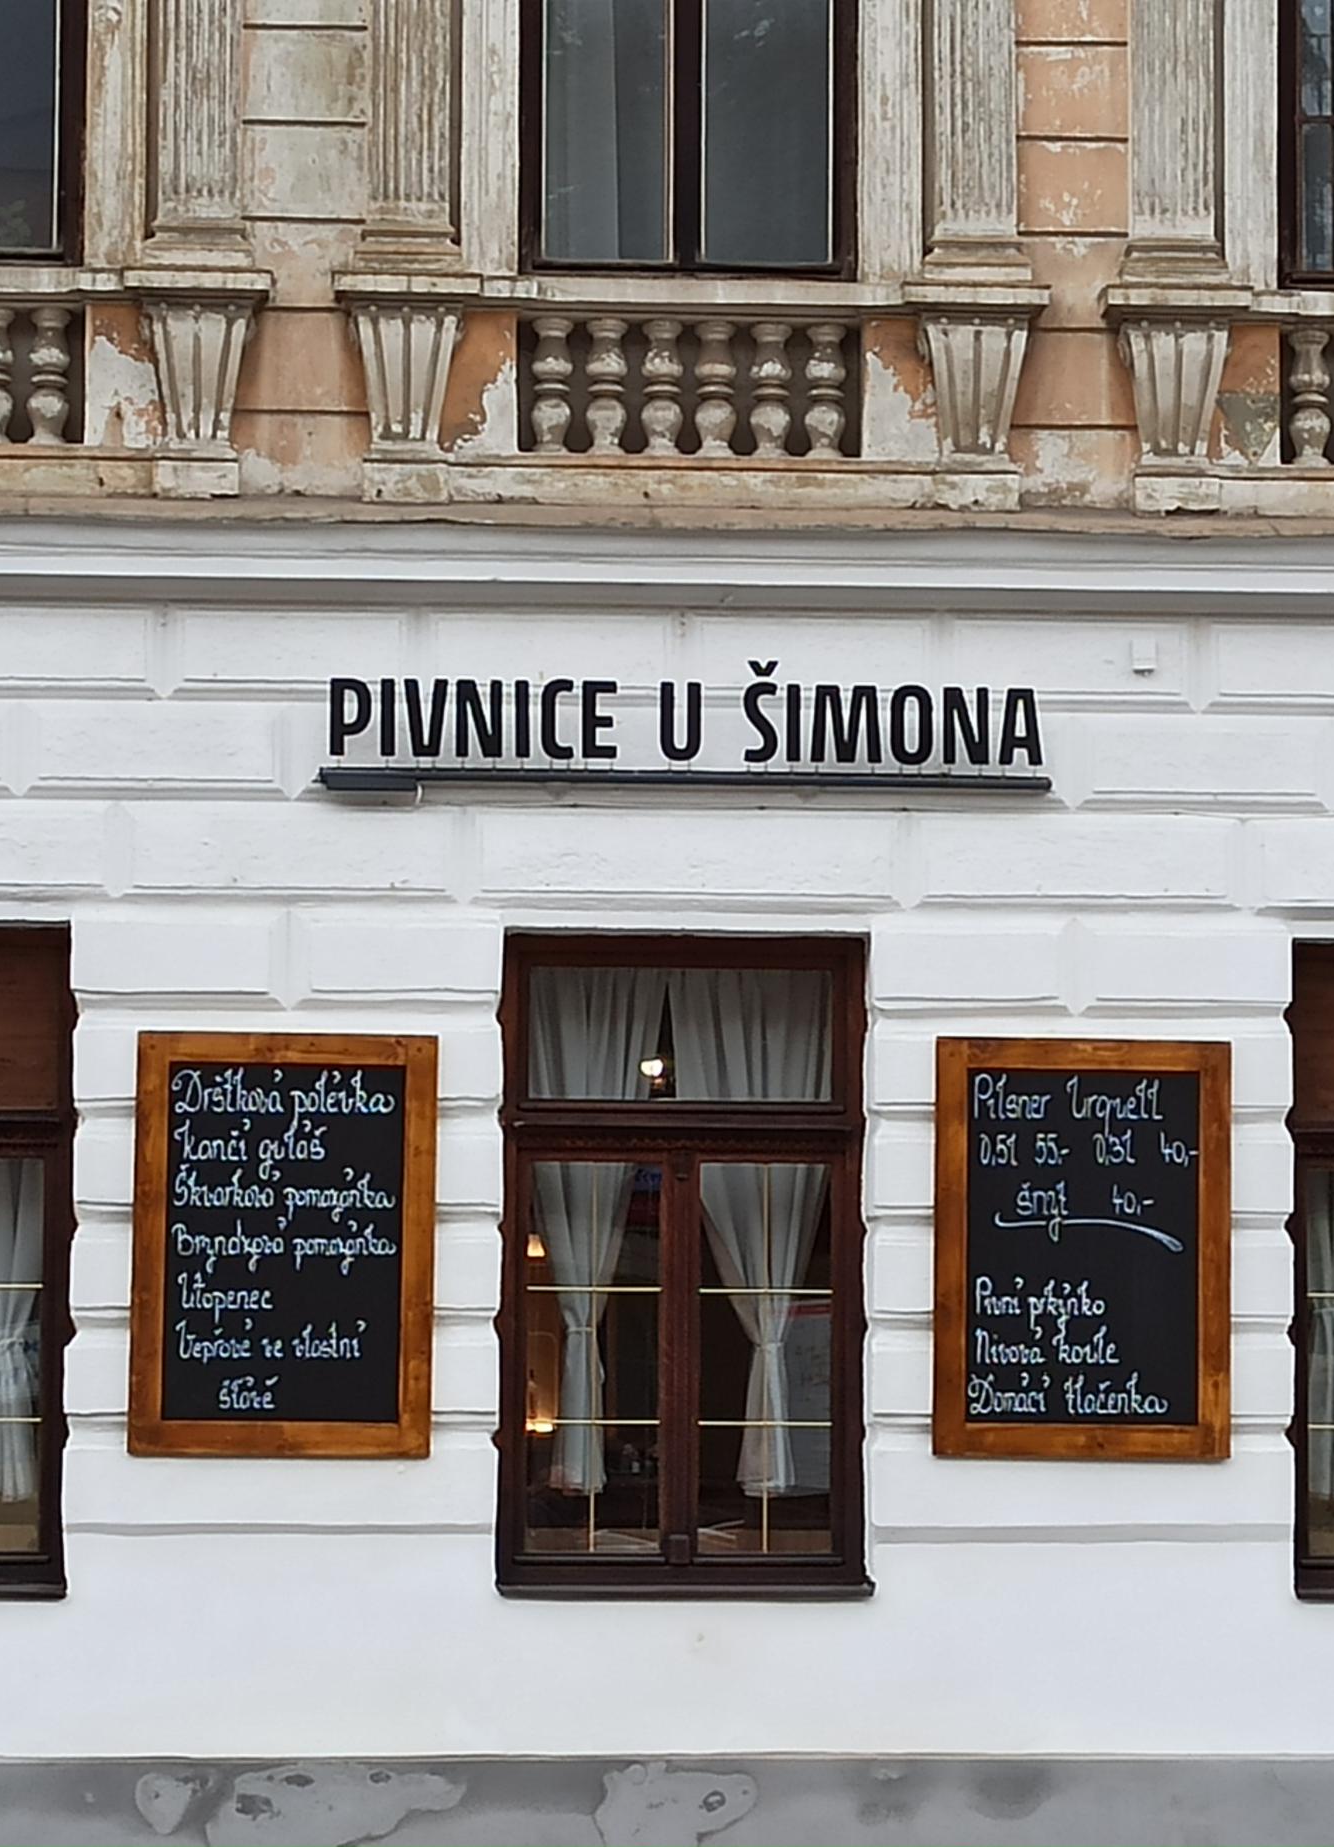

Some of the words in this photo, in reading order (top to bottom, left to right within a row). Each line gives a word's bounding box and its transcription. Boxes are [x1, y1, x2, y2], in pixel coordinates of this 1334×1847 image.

[329, 676, 618, 760] PIVNICE
[660, 680, 703, 762] U
[742, 659, 1046, 766] ŠIMONA
[289, 1069, 397, 1126] polévka
[973, 1072, 1052, 1120] Pilsner
[1066, 1074, 1164, 1137] Urquell
[173, 1118, 249, 1162] Kančí
[258, 1118, 329, 1181] guláš
[1158, 1130, 1200, 1168] 40,-
[282, 1166, 397, 1223] pomazánka
[1111, 1183, 1155, 1217] 40,-
[170, 1215, 288, 1275] Bryndzová
[291, 1219, 398, 1276] pomazánka
[176, 1271, 275, 1325] Utopenec
[974, 1275, 1025, 1316] Pivní
[260, 1336, 285, 1359] ve
[290, 1319, 368, 1360] vlastní
[974, 1325, 1048, 1366] Nivová
[1050, 1320, 1121, 1366] koule
[1062, 1370, 1169, 1416] tlačenka
